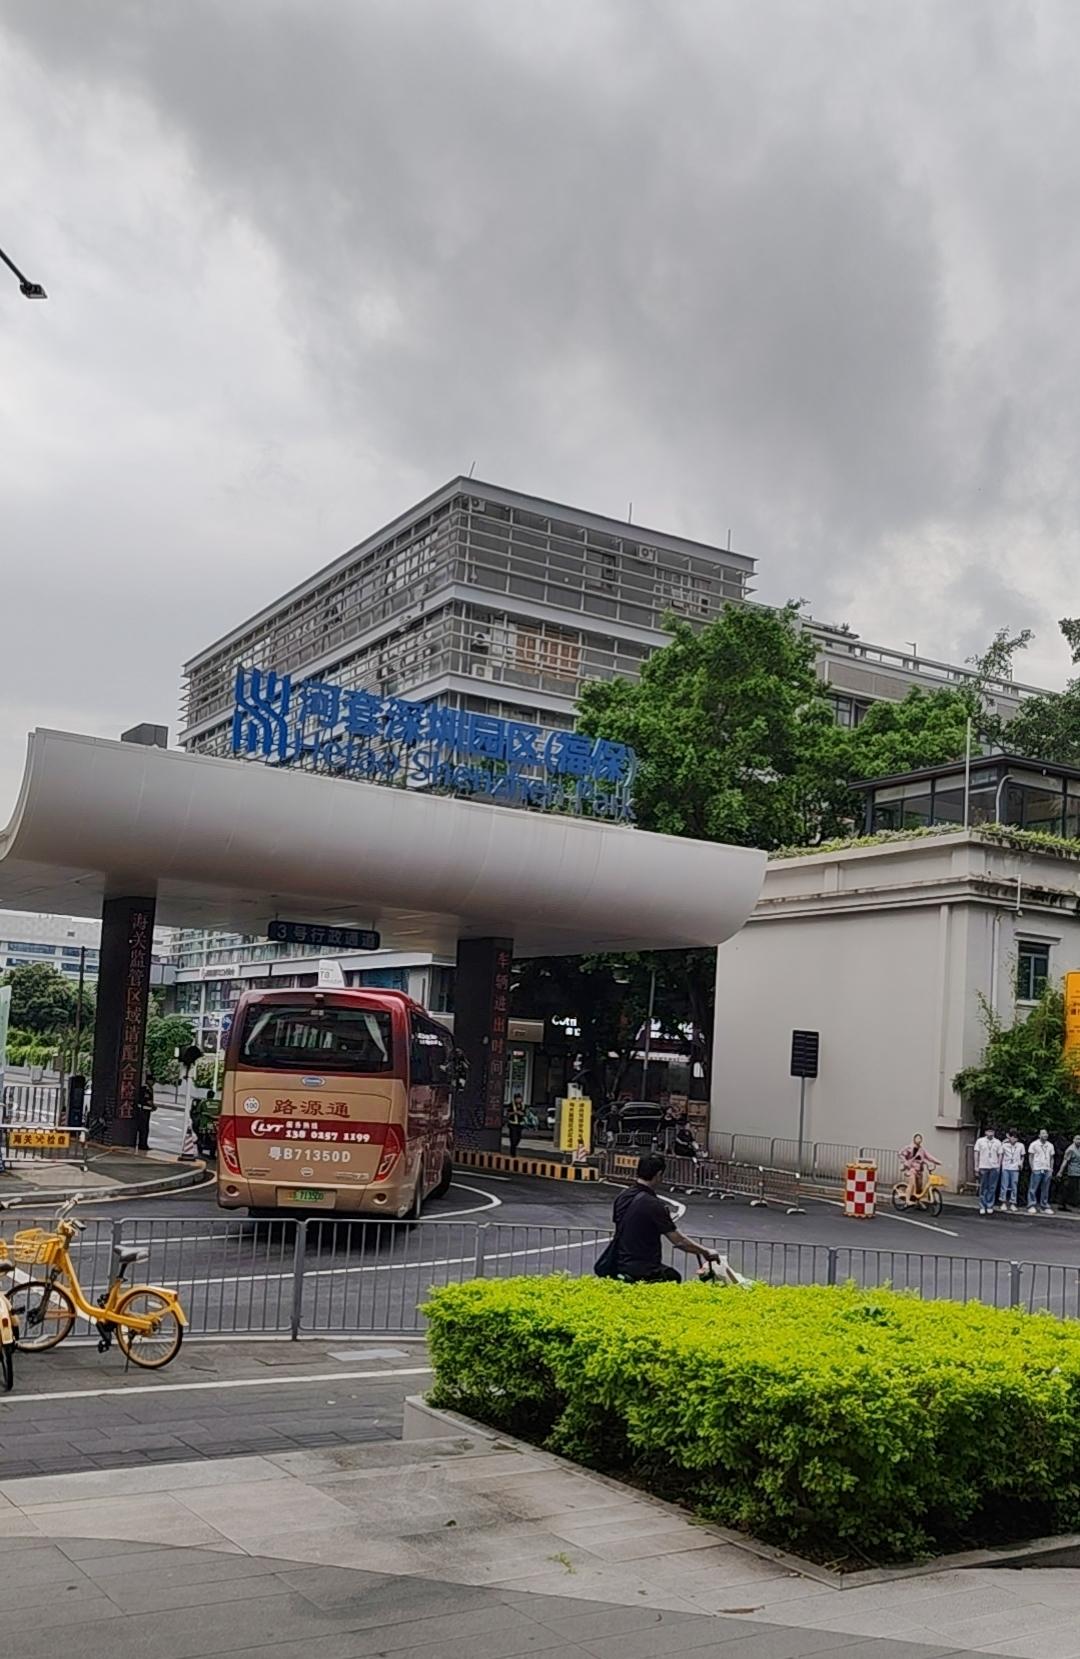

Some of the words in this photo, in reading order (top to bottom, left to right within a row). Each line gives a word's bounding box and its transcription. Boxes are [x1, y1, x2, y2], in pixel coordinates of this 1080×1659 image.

[294, 729, 399, 774] Hetao
[412, 748, 563, 808] Shenzhen
[576, 781, 637, 823] Park
[273, 1099, 351, 1118] 路源通
[285, 1130, 306, 1139] 138
[311, 1131, 338, 1141] 0257
[343, 1133, 371, 1143] 1199
[268, 1146, 352, 1164] 粤B71350D
